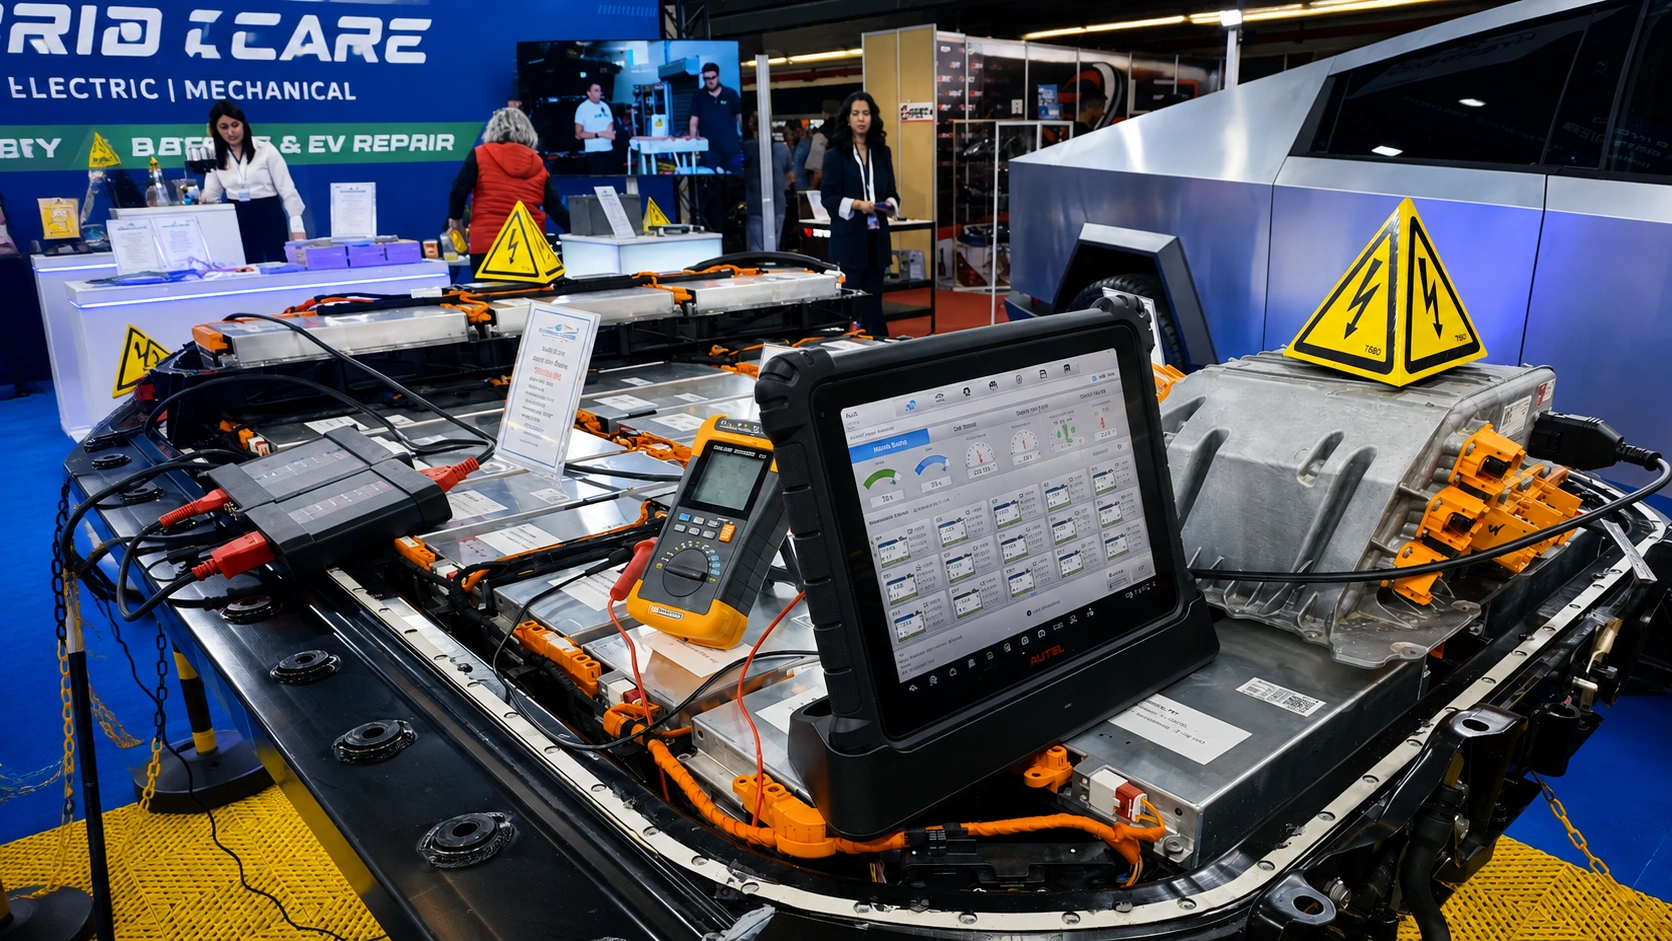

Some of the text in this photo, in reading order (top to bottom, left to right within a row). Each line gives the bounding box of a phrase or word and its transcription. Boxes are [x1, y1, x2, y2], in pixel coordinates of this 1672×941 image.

[0, 3, 162, 57] RID
[184, 80, 357, 101] MECHANICAL
[308, 135, 346, 153] EV
[353, 134, 455, 153] REPAIR
[1030, 644, 1065, 667] AUTEL
